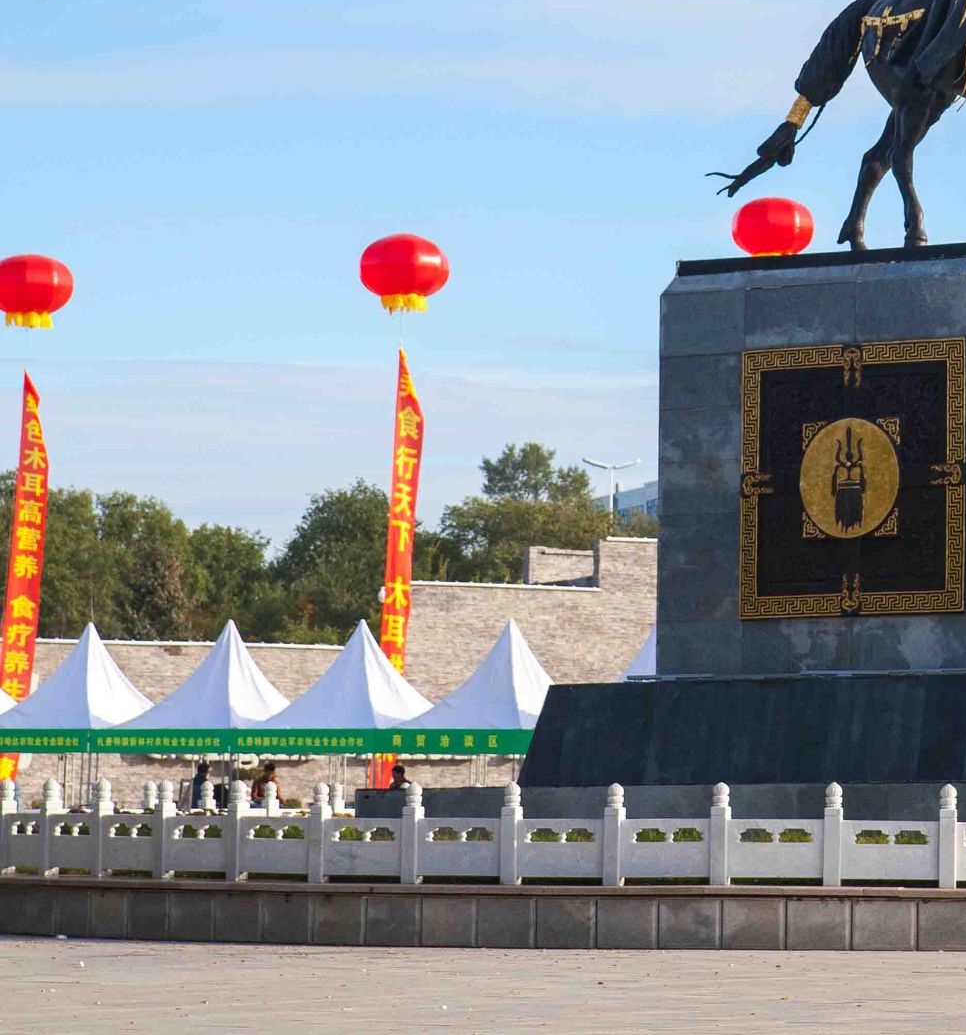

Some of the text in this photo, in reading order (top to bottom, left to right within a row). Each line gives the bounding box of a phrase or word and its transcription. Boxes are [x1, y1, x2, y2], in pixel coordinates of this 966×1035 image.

[392, 734, 498, 747] 商贸洽谈区
